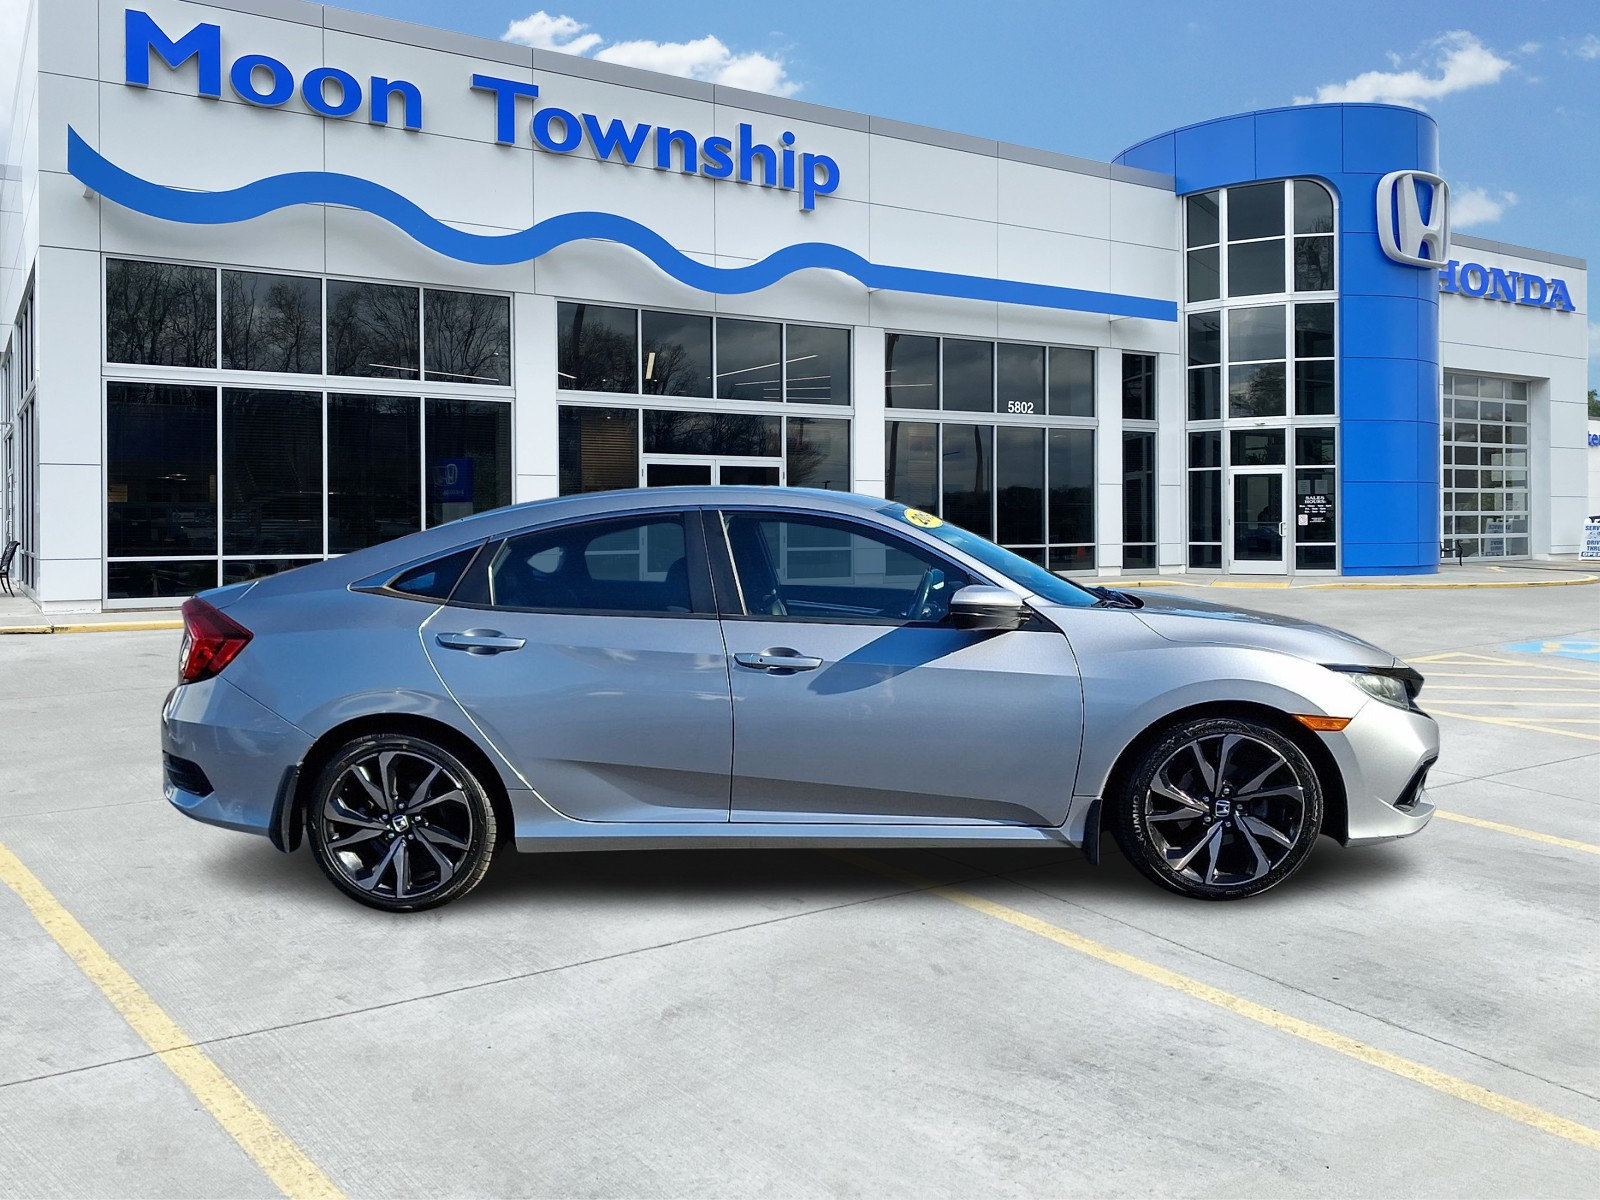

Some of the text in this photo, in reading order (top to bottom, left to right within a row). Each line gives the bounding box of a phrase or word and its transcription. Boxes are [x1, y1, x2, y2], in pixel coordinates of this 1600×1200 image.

[125, 8, 840, 213] Moon Township
[1007, 400, 1034, 414] 5802
[1132, 794, 1144, 841] KUMHO
